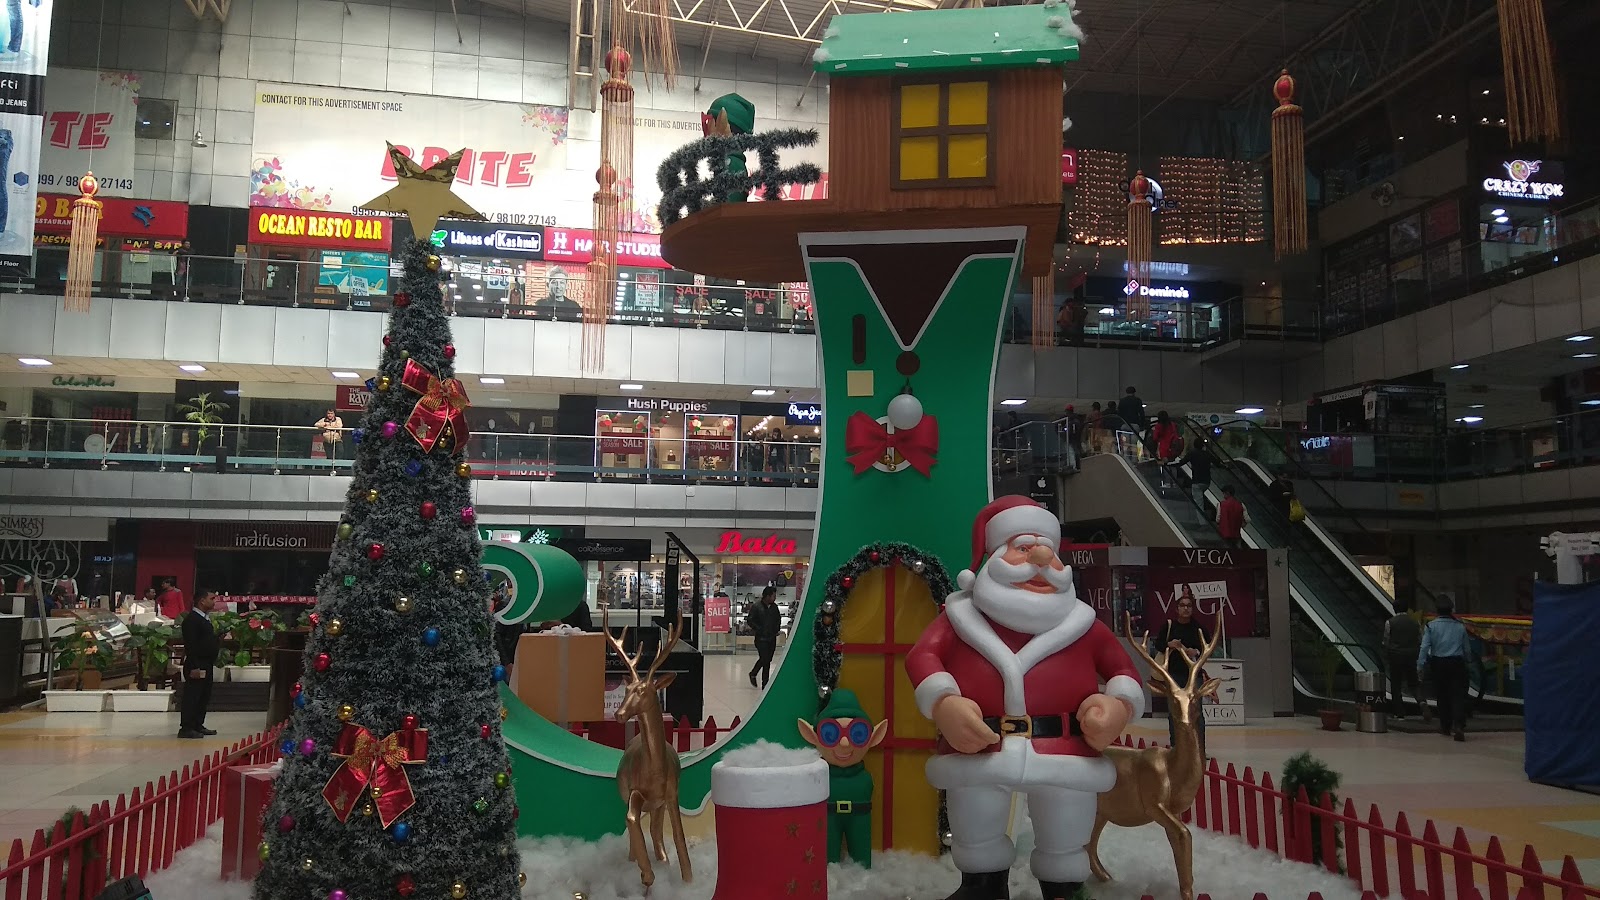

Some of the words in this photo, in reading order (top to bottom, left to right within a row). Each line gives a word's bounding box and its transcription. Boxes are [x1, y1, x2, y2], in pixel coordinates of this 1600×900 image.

[6, 99, 28, 107] JEANS
[262, 94, 291, 105] CONTACT
[294, 96, 306, 106] FOR
[309, 96, 323, 107] THIS
[325, 97, 380, 111] ADVERTISEMENT
[382, 101, 403, 112] SPACE
[643, 118, 656, 127] FOR
[657, 119, 671, 129] THIS
[101, 178, 133, 190] 27143
[1484, 178, 1529, 193] CRAZY
[1530, 182, 1564, 197] WOK
[497, 213, 525, 225] 98102
[528, 214, 556, 226] 27143
[258, 213, 306, 236] OCEAN
[308, 216, 353, 239] RESTO
[354, 219, 383, 240] BAR
[451, 231, 482, 246] Libaas
[484, 234, 496, 246] of
[498, 233, 539, 249] Kashmir
[4, 261, 20, 269] Floor
[676, 284, 710, 297] SALE
[745, 289, 777, 300] SALE
[628, 398, 658, 410] Hush
[660, 399, 707, 412] Puppies
[622, 438, 643, 448] SALE
[709, 441, 730, 451] SALE
[236, 530, 307, 547] indifusion
[715, 531, 797, 555] Bata
[1072, 550, 1094, 565] VEGA
[1183, 549, 1234, 565] VEGA
[1195, 584, 1223, 593] VEGA
[708, 606, 728, 617] SALE
[1204, 708, 1237, 718] VEGA
